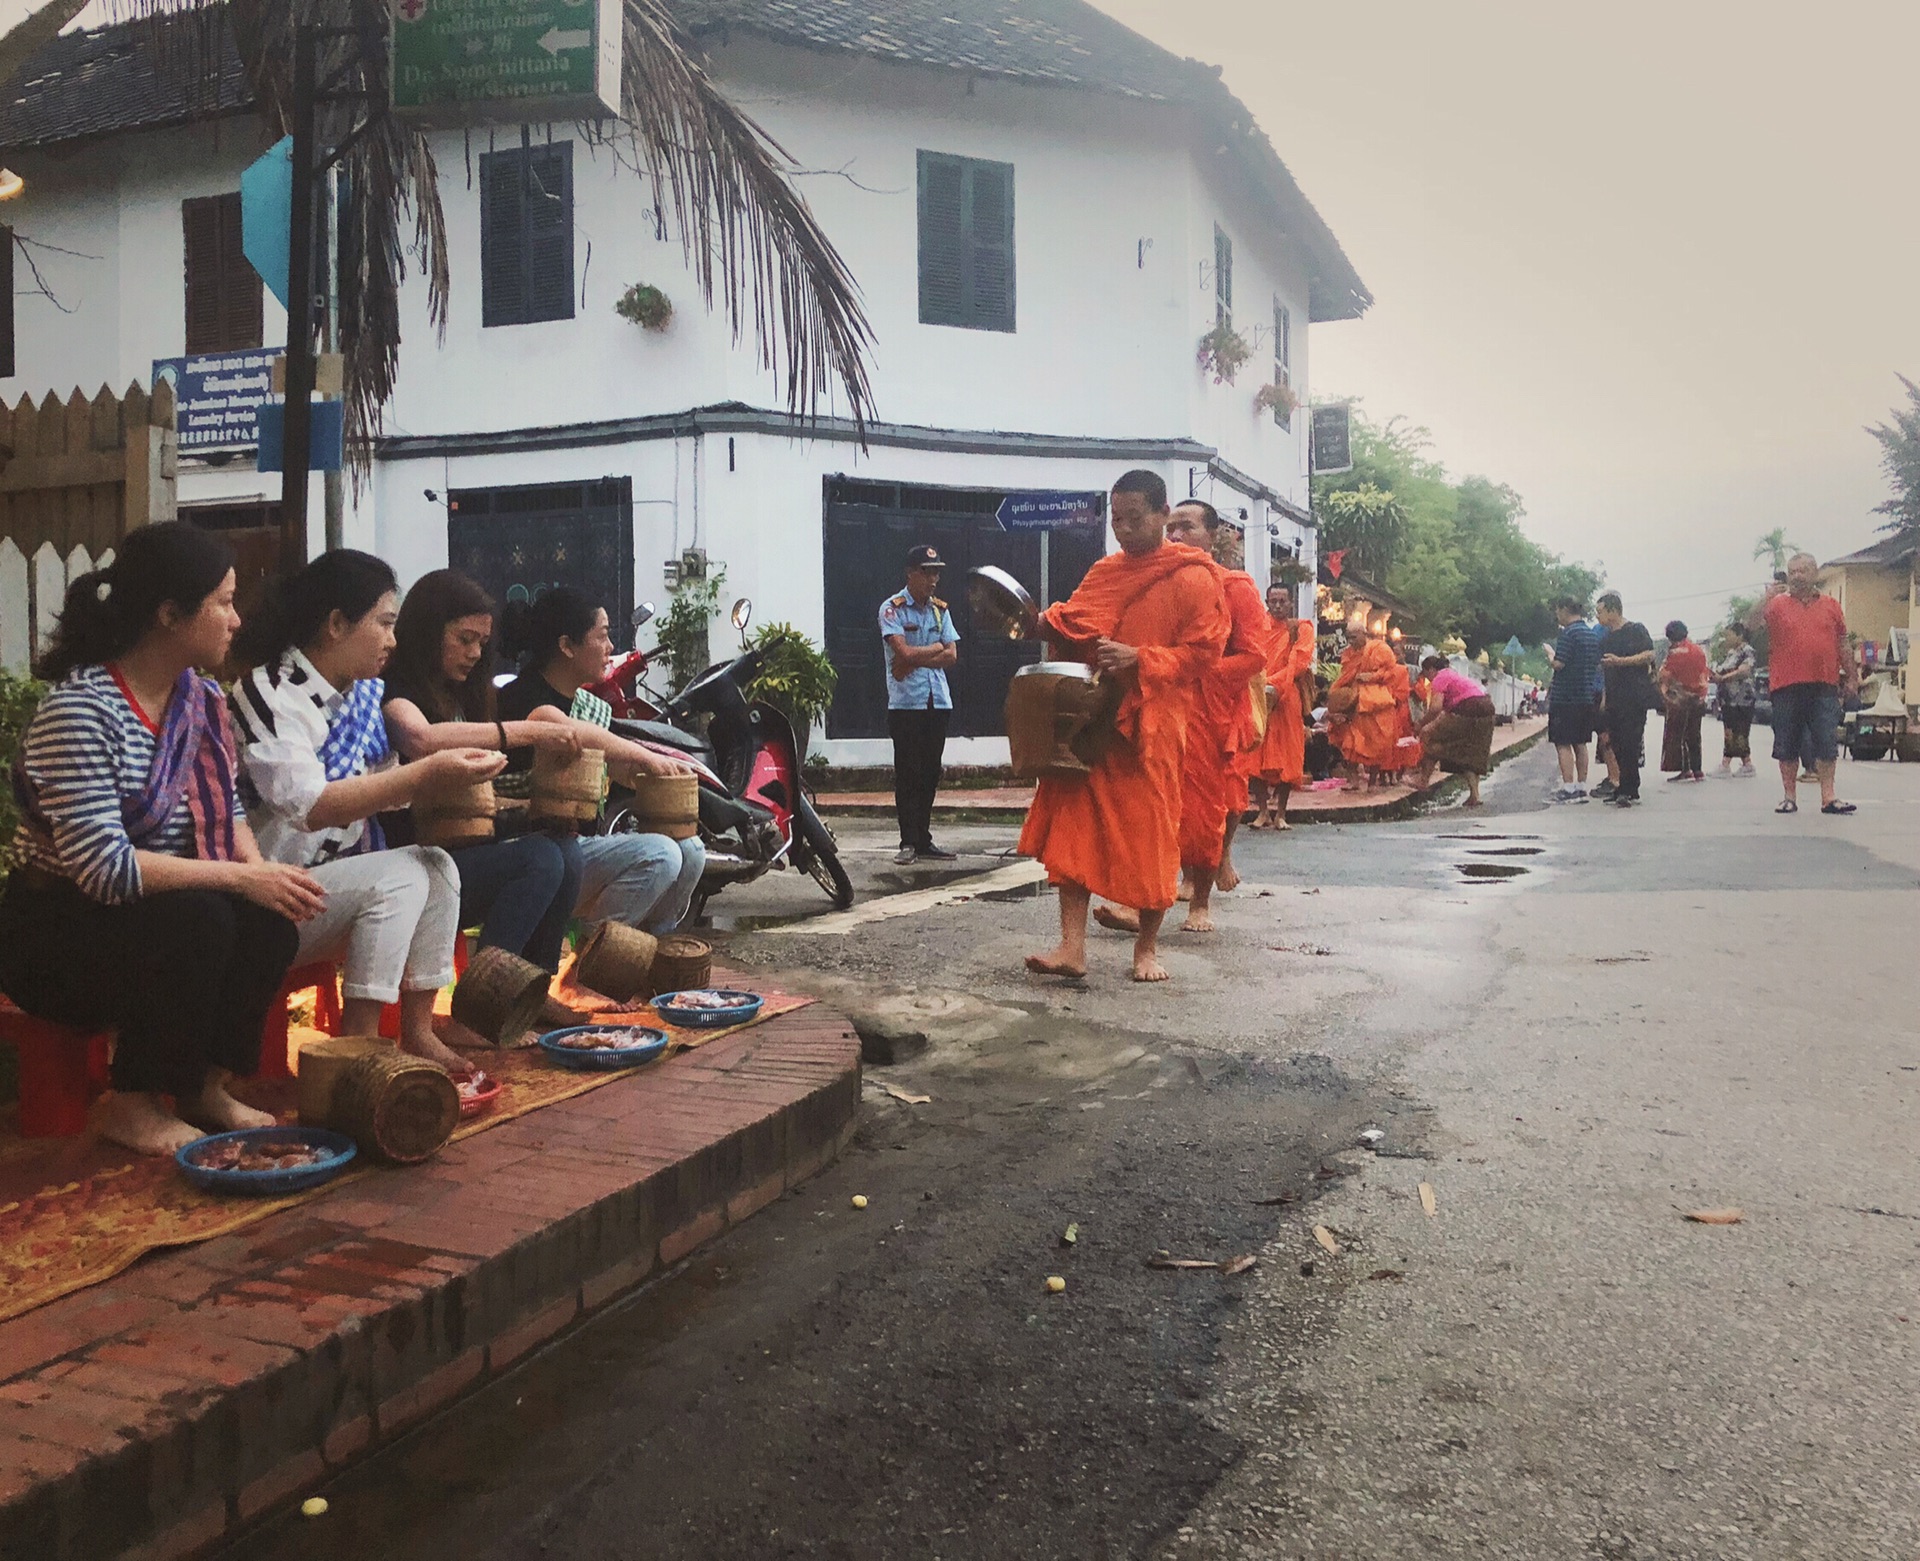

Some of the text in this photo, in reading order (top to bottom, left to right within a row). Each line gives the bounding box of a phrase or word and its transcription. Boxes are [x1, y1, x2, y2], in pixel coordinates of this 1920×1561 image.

[228, 395, 264, 408] Massage
[188, 409, 256, 427] Laundry Service
